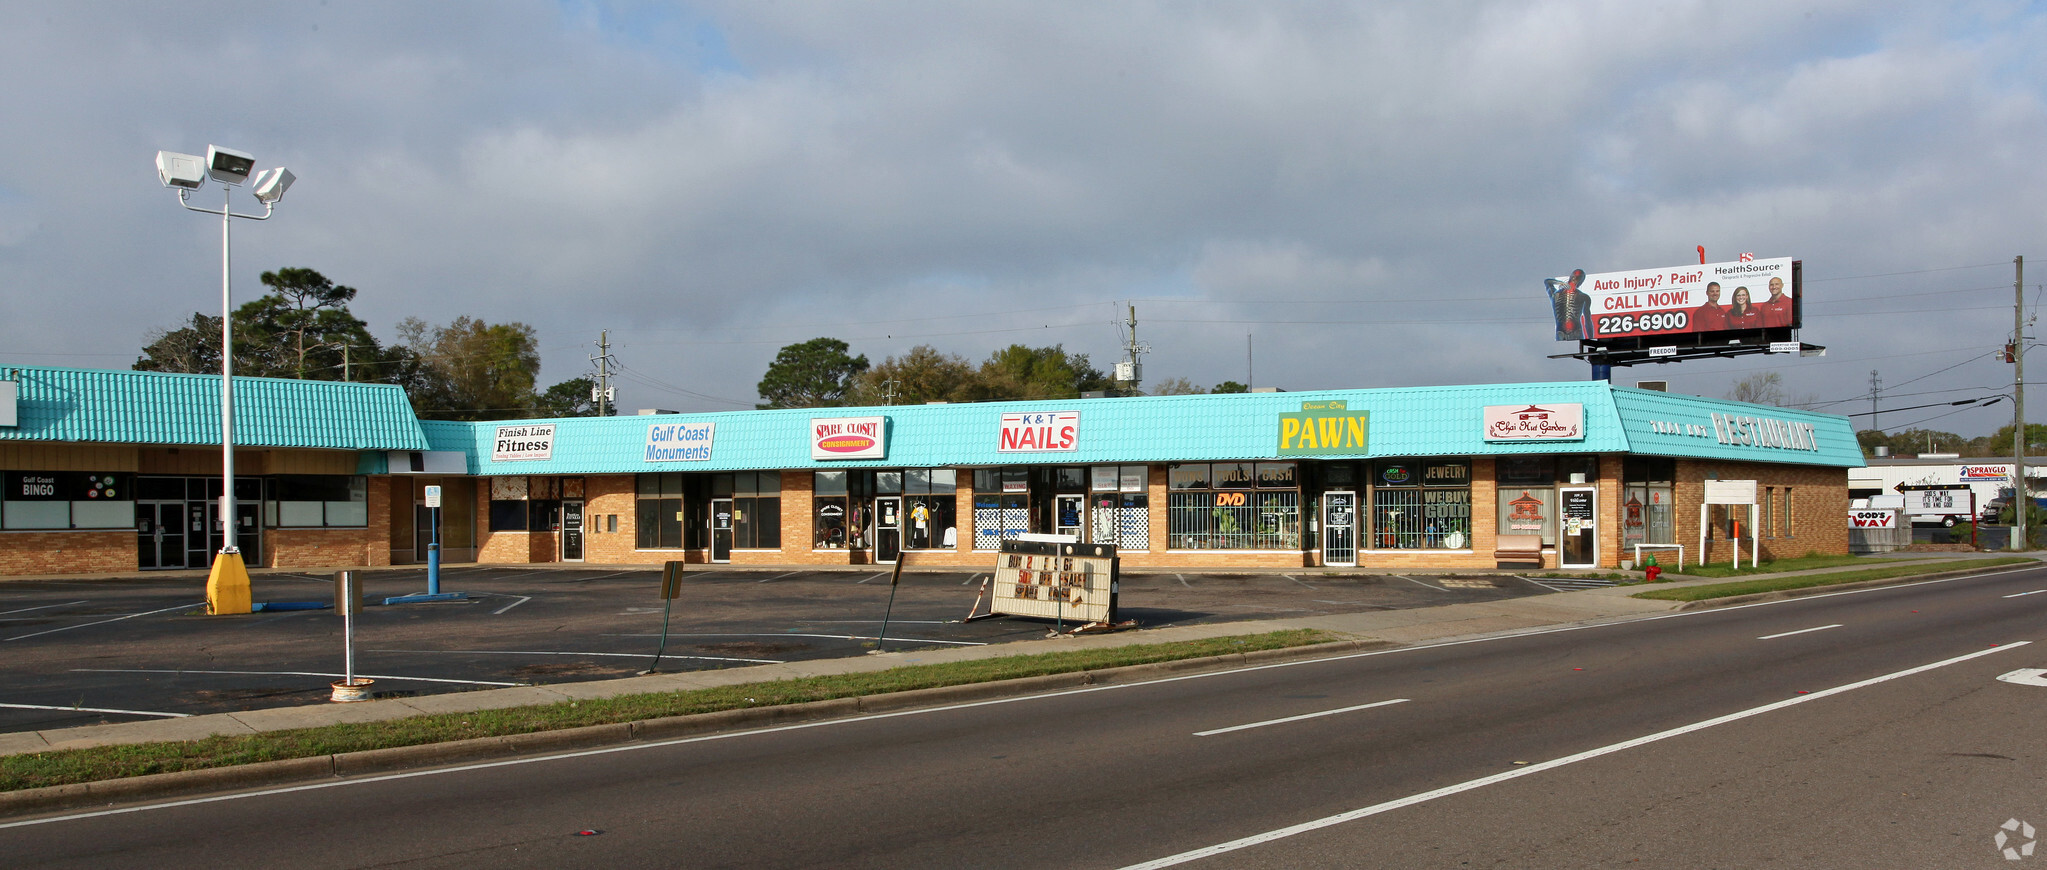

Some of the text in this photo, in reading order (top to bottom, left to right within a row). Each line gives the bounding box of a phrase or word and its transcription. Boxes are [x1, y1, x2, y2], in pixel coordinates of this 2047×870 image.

[1715, 264, 1780, 274] HealthSource
[1594, 271, 1703, 291] Auto Injury? Pain?
[1604, 291, 1689, 310] CALL NOW!
[1599, 312, 1687, 334] 226-6900
[1650, 347, 1676, 355] FREEDOM
[1303, 401, 1345, 410] Ocean City
[1023, 414, 1056, 425] K & T
[498, 427, 552, 437] Finish Line
[652, 425, 710, 442] Gulf Coast
[816, 422, 877, 440] SPARE CLOSET
[1280, 416, 1366, 449] PAWN
[1495, 420, 1567, 434] Thai Hut Garden
[1650, 419, 1682, 435] THAI
[1711, 412, 1819, 452] RESTAURANT
[822, 440, 870, 448] CONSIGNMENT
[1001, 426, 1075, 449] NAILS
[497, 439, 549, 452] Fitness
[646, 444, 710, 460] Monuments
[1174, 469, 1293, 482] GUNS TOOLS CASH
[1425, 466, 1467, 479] JEWELRY
[1970, 466, 2006, 474] SPRAYGLO
[23, 484, 54, 495] BINGO
[1216, 493, 1246, 506] DVD
[1425, 491, 1468, 503] WE BUY
[1425, 504, 1470, 518] GOLD
[1851, 515, 1892, 527] WAY
[1008, 555, 1022, 568] BUY
[1027, 556, 1033, 569] 2
